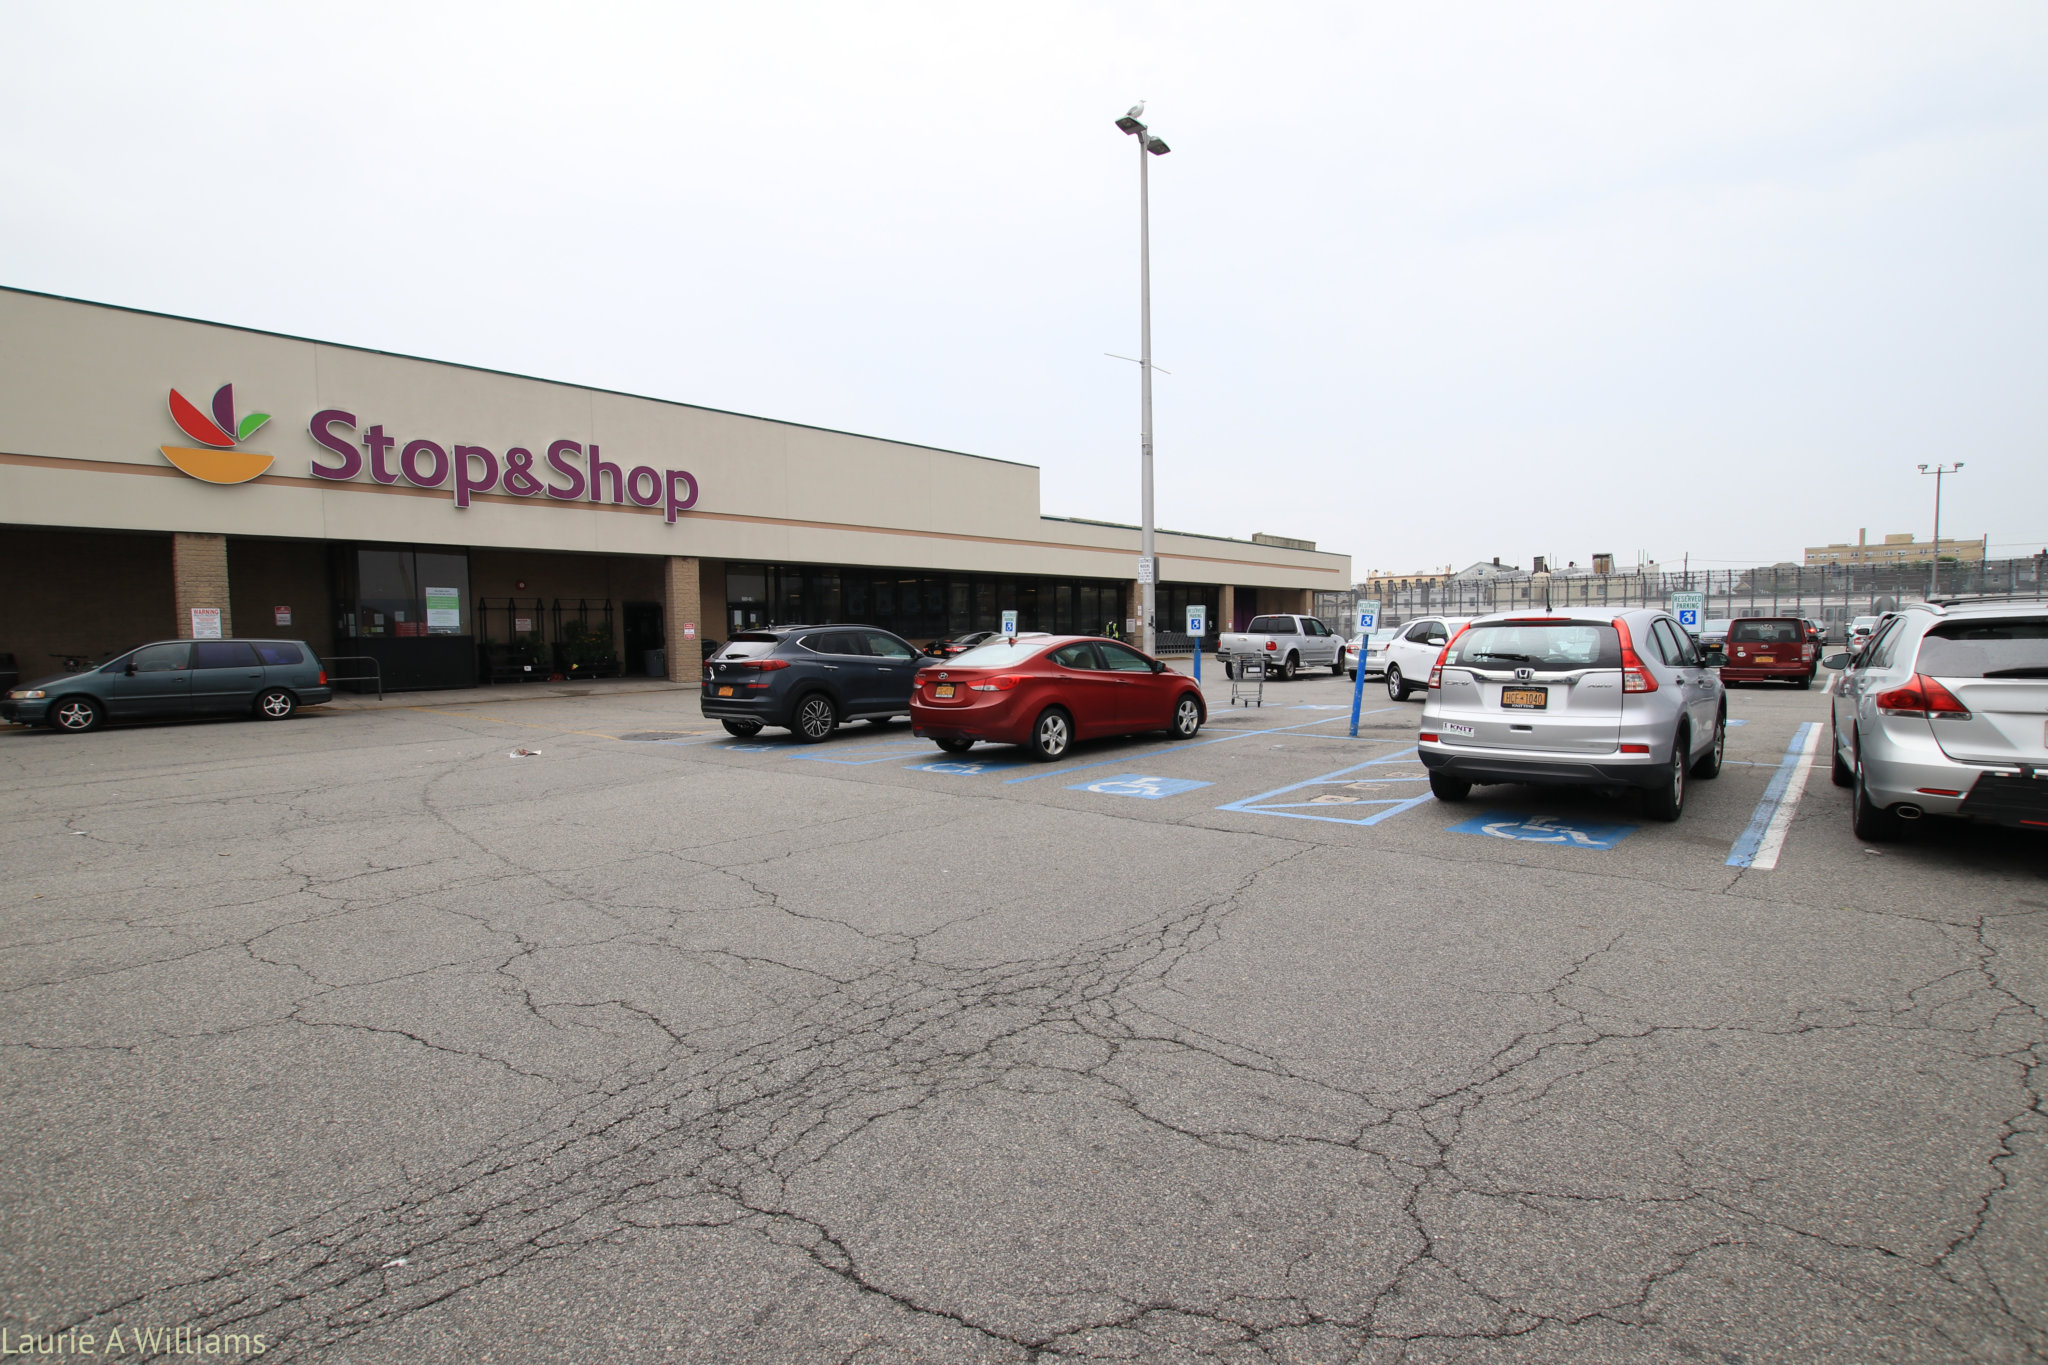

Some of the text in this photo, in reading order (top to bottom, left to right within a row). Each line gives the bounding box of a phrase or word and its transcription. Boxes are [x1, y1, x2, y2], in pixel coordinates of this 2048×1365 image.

[1506, 692, 1543, 705] HCF 1040
[1450, 723, 1474, 732] KNIT
